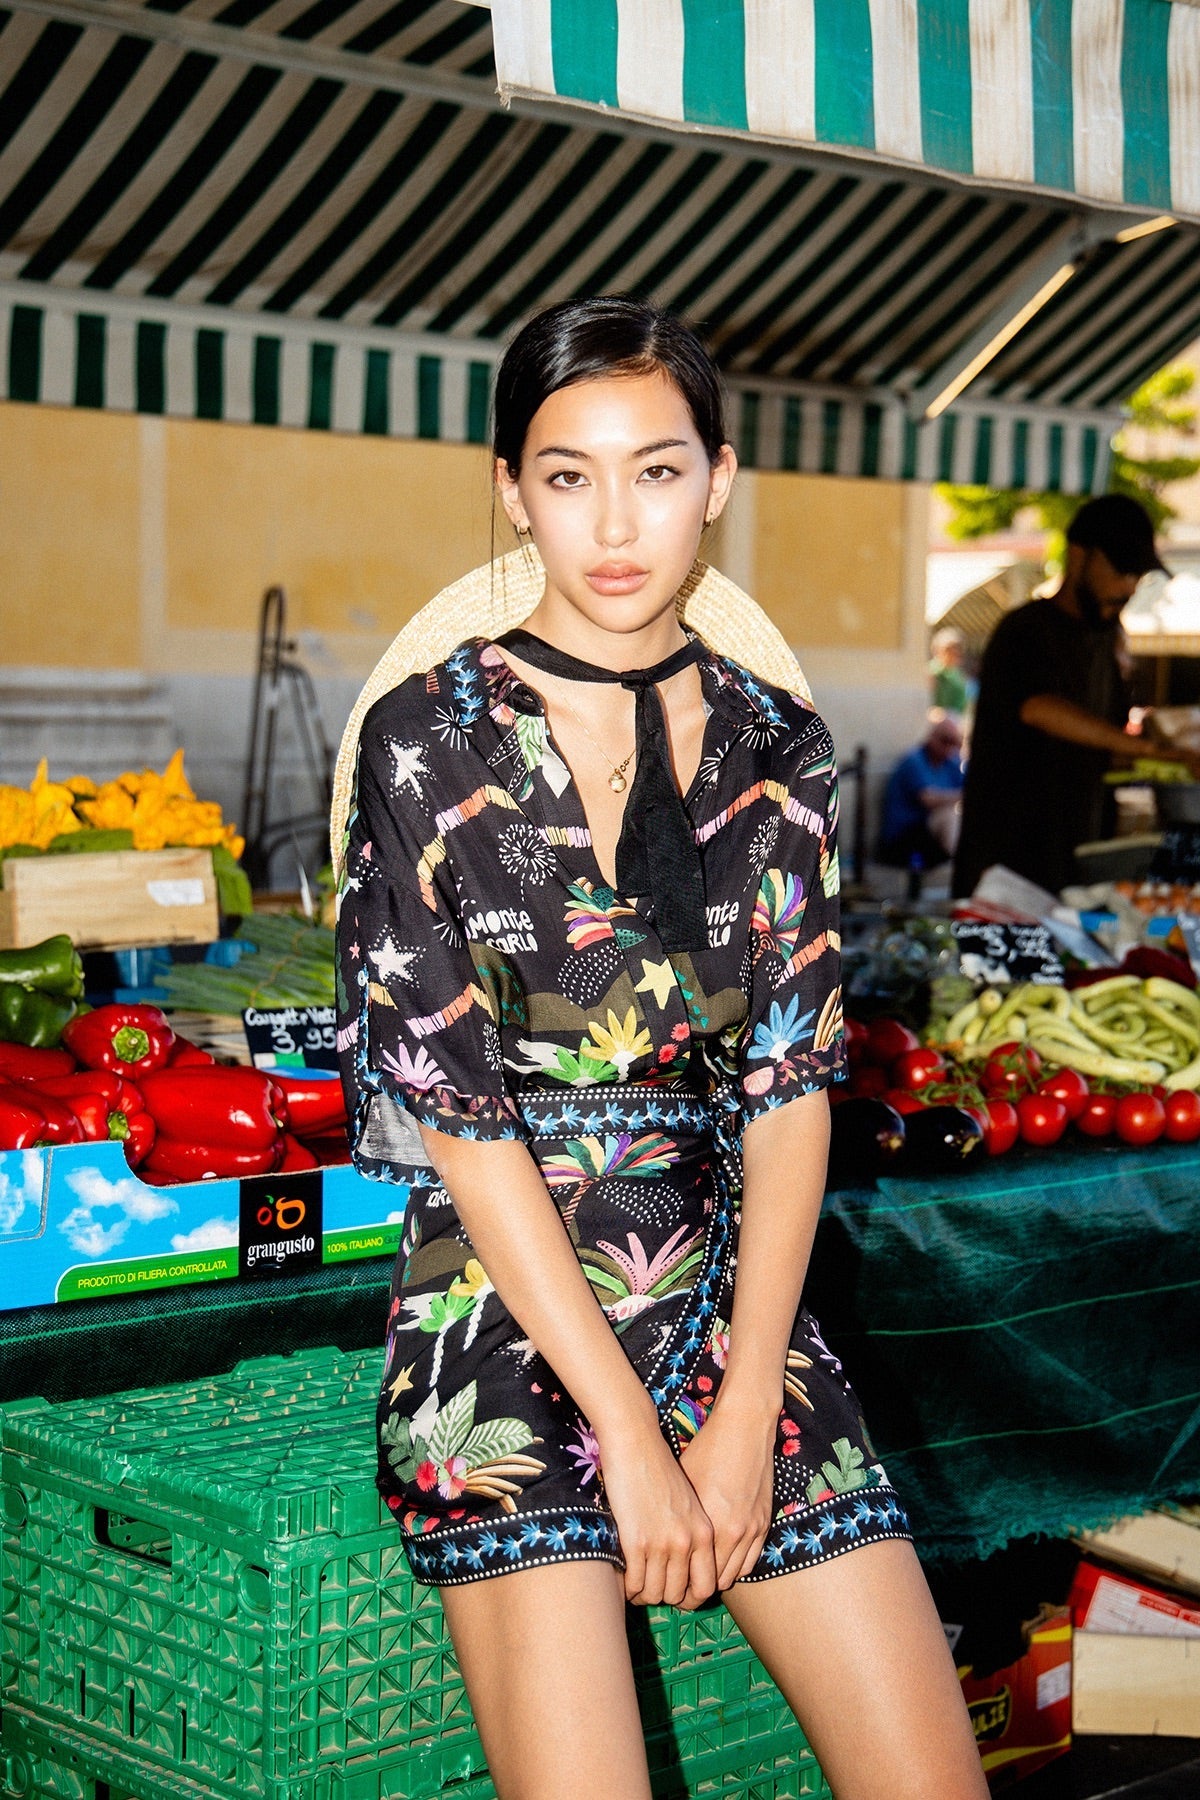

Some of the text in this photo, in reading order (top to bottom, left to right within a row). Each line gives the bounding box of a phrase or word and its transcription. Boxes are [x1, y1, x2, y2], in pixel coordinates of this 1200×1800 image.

[247, 1235, 315, 1267] grangusto
[327, 1242, 348, 1254] 100%
[349, 1237, 383, 1251] ITALIANO
[78, 1260, 228, 1289] PRODOTTO DI FILIERA CONTROLLATA
